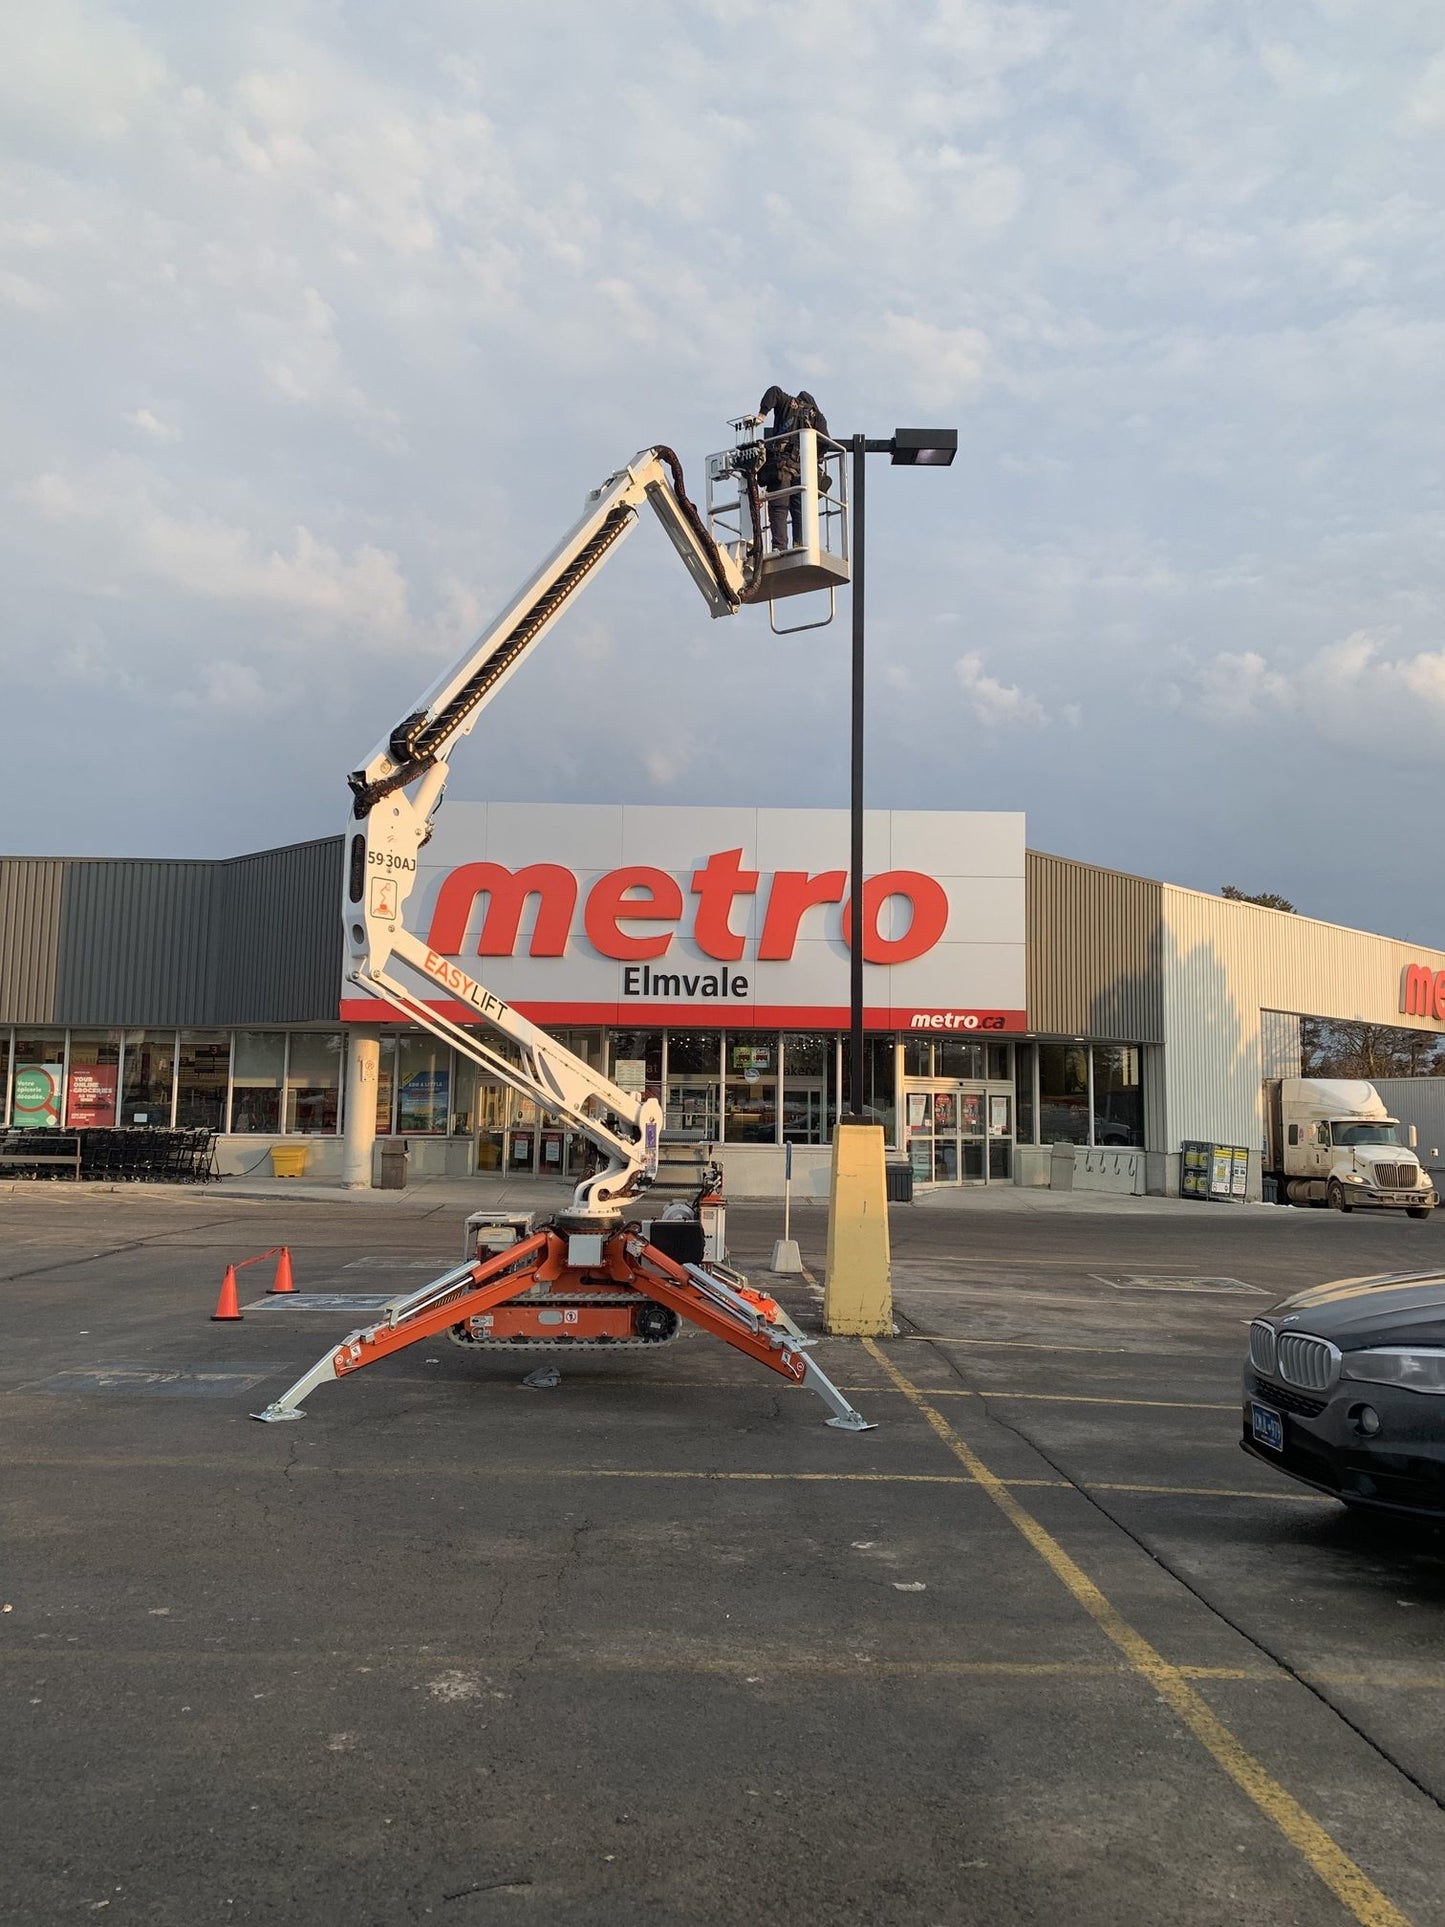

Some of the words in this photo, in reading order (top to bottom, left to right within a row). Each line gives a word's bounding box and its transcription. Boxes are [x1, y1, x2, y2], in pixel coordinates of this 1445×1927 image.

[368, 851, 416, 872] 5930AJ
[427, 847, 949, 964] metro
[423, 950, 508, 1021] EASYLIFT
[624, 966, 749, 998] Elmvale
[910, 1012, 1006, 1030] metro.ca
